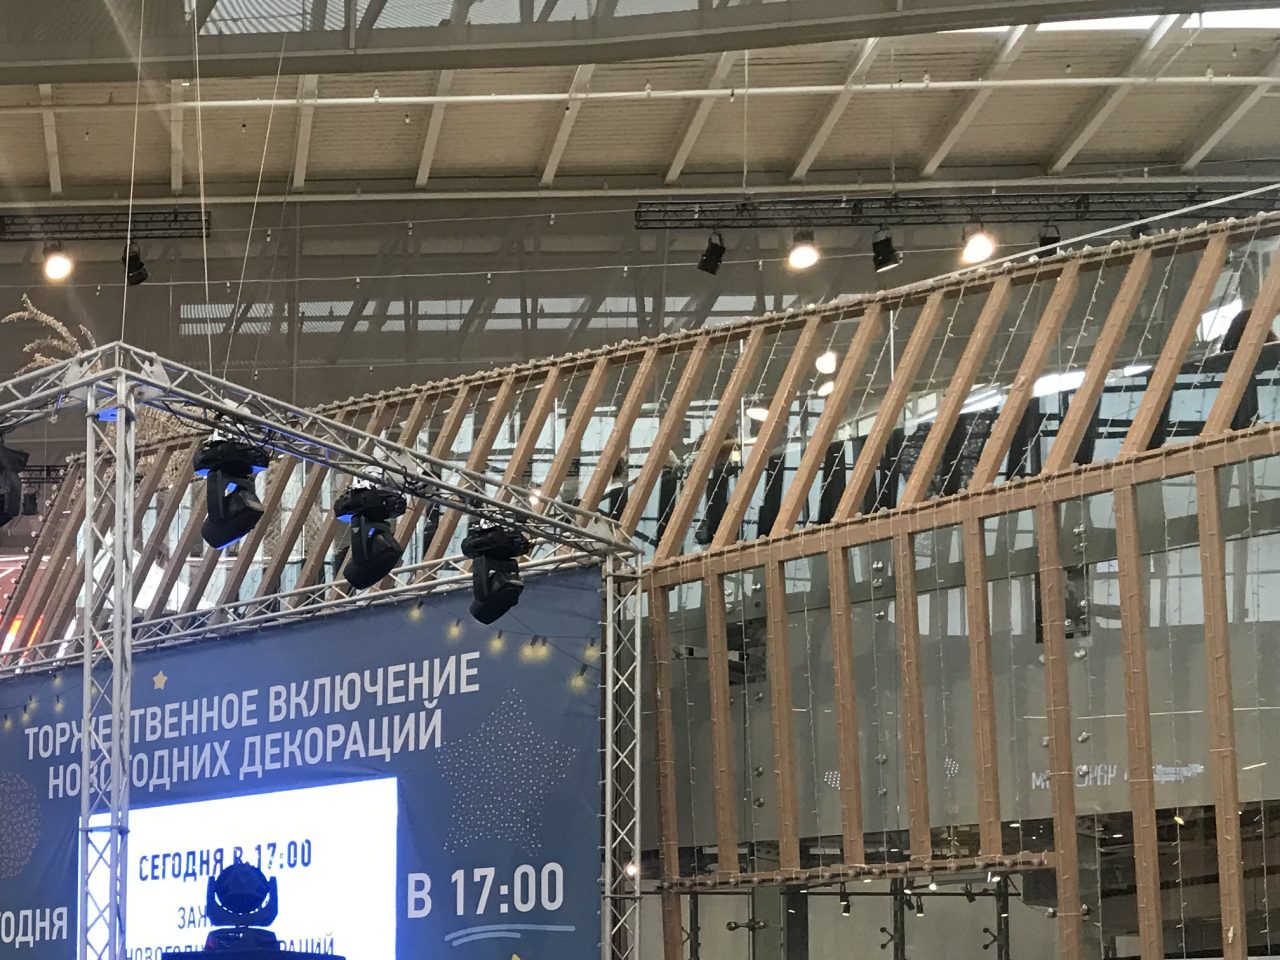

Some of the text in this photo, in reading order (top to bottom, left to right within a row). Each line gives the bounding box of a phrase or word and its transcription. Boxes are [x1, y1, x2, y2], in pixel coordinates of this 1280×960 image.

[24, 651, 480, 760] ТОРЖЕТВЕННОЕ ВКЛЮЧЕНИЕ
[48, 698, 442, 800] НОВООДНИХ ДЕКОРАЦИЙ
[139, 849, 224, 883] СЕГОДНЯ
[407, 862, 564, 918] В 17:00
